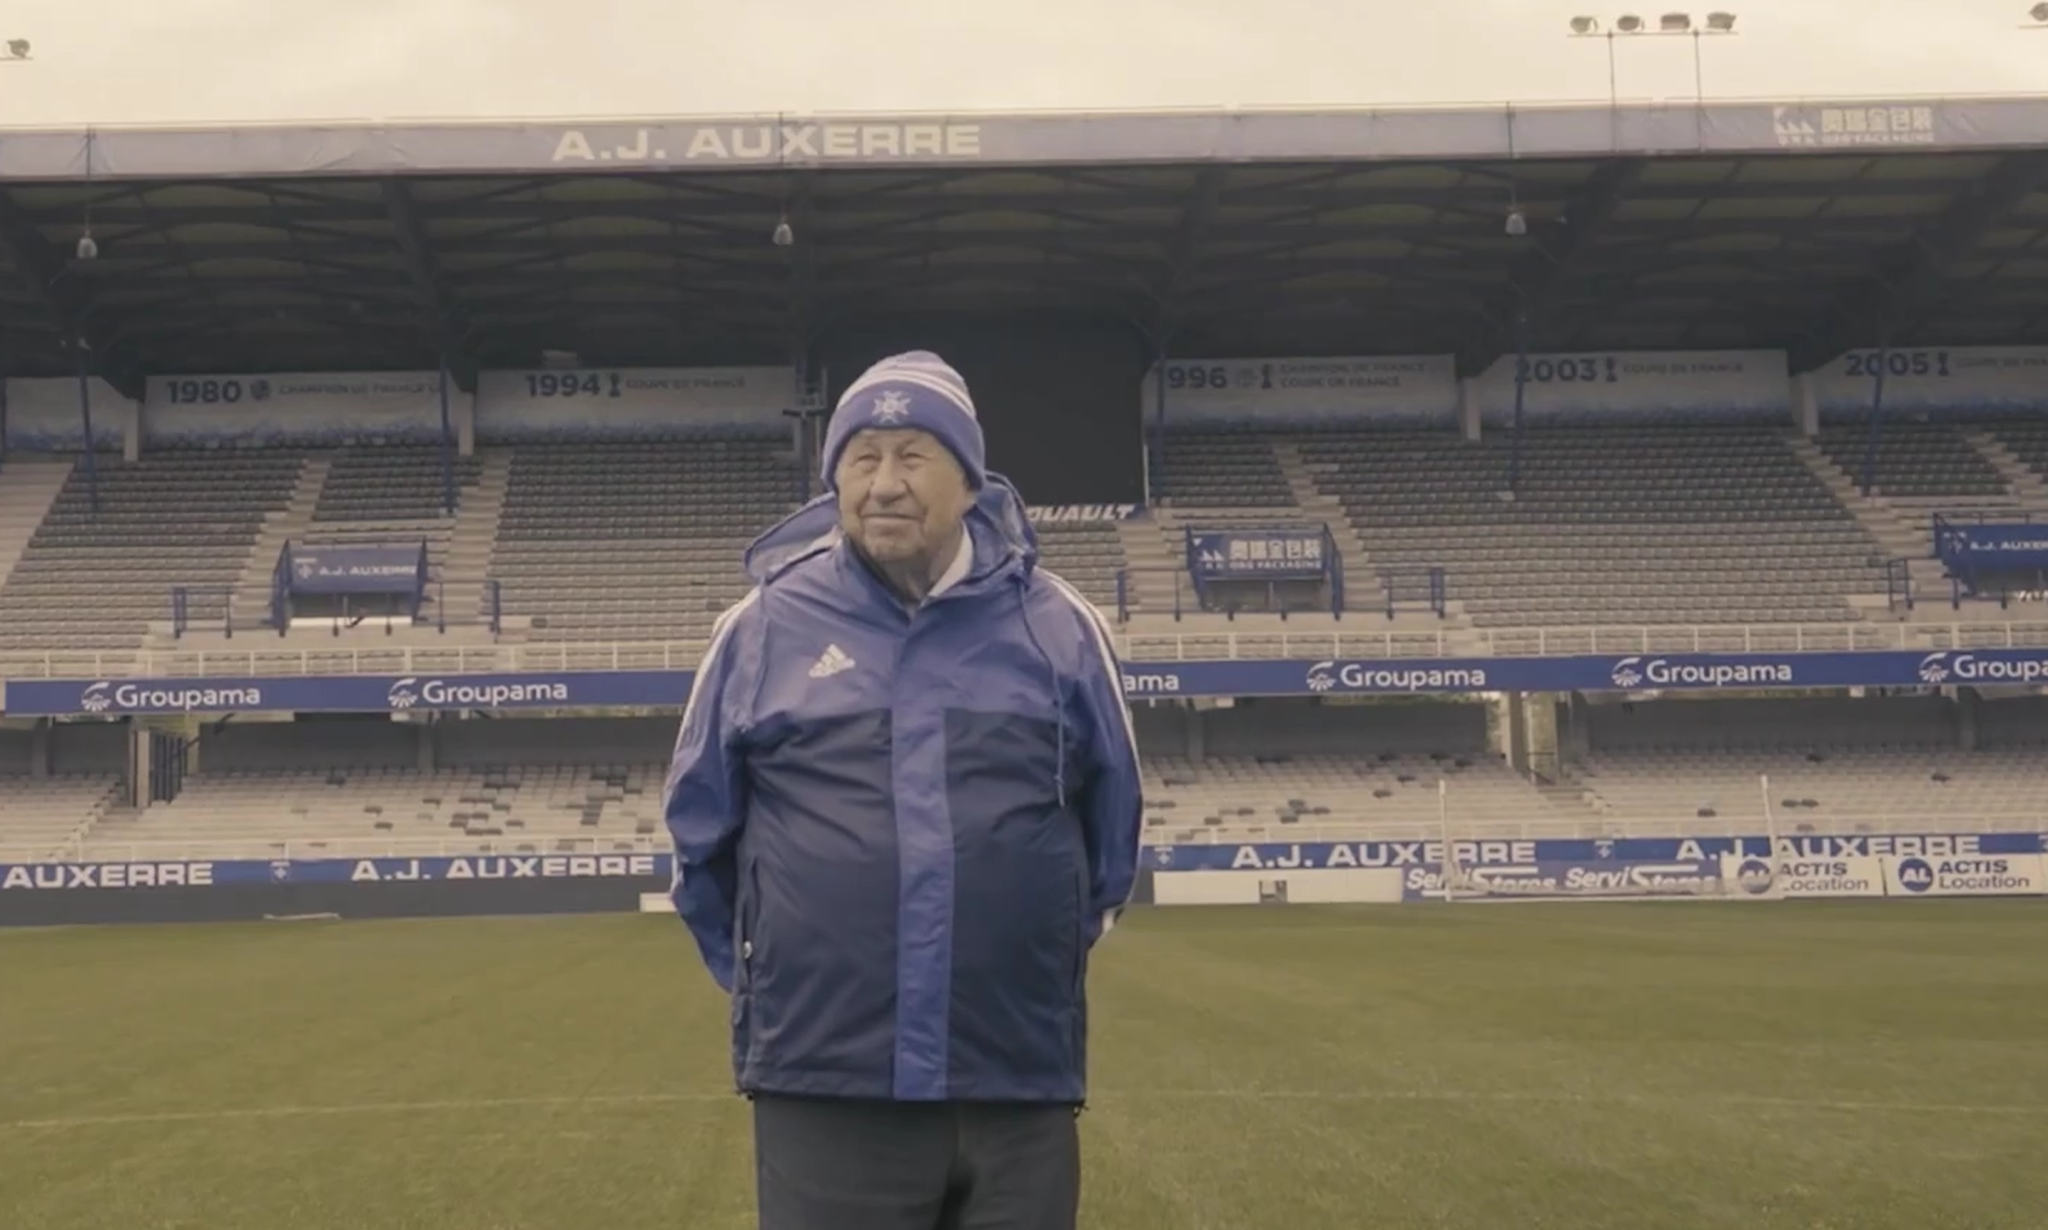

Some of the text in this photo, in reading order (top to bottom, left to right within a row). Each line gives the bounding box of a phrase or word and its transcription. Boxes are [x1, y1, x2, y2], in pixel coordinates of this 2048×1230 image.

[551, 124, 981, 161] A.J. AUXERRE
[1844, 352, 1928, 377] 2005
[525, 373, 600, 397] 1994
[1154, 365, 1227, 390] 996
[165, 379, 242, 404] 1980
[1340, 664, 1486, 692] Groupama
[1645, 659, 1792, 686] Groupama
[1953, 654, 2048, 681] Groupa
[423, 679, 568, 704] Groupama
[1124, 672, 1180, 691] ama
[115, 684, 261, 710] Groupama
[1231, 841, 1537, 868] A.J. AUXERRE
[1772, 835, 1980, 857] AUXERRE
[2, 863, 213, 889] AUXERRE
[350, 855, 655, 881] A.J. AUXERRE
[1938, 858, 2008, 874] ACTIS
[1782, 877, 1869, 892] ocation
[1938, 874, 2031, 890] Location
